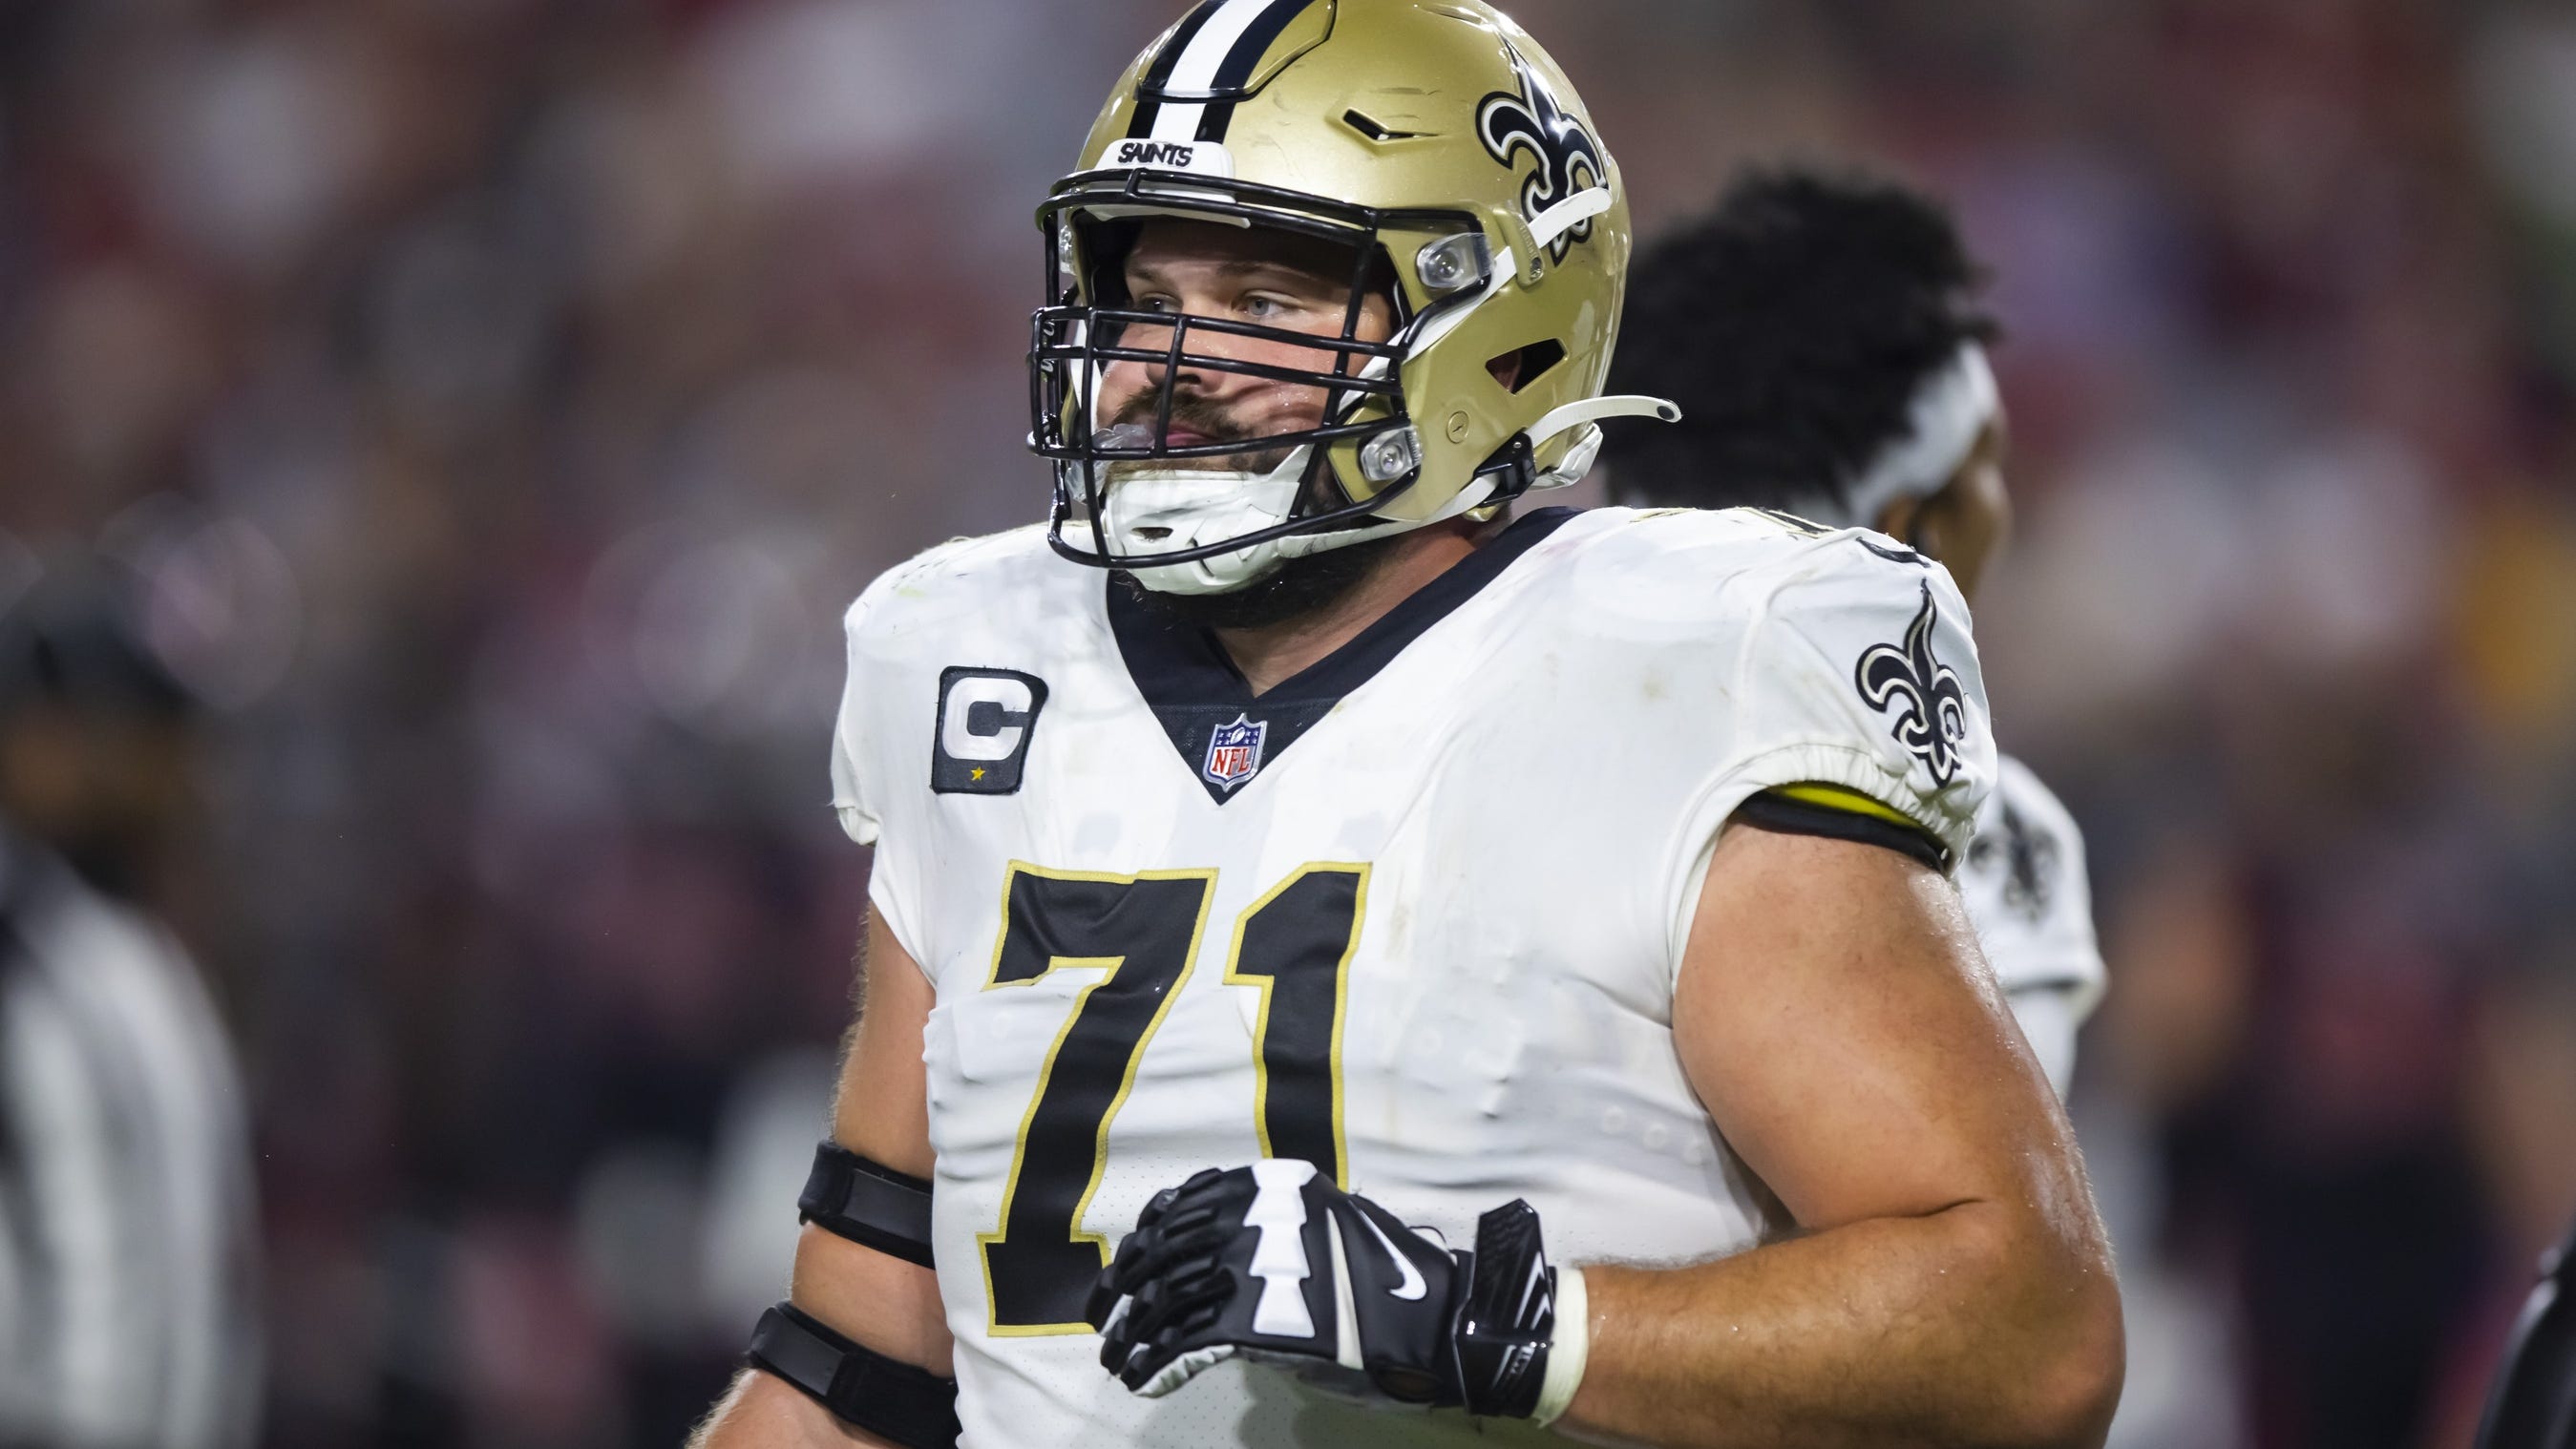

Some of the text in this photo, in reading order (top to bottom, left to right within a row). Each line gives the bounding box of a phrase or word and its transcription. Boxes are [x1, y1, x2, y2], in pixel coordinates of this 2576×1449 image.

[1118, 142, 1193, 167] SAINTS
[942, 677, 1032, 760] C
[1212, 748, 1250, 775] NFL
[976, 859, 1373, 1336] 71
